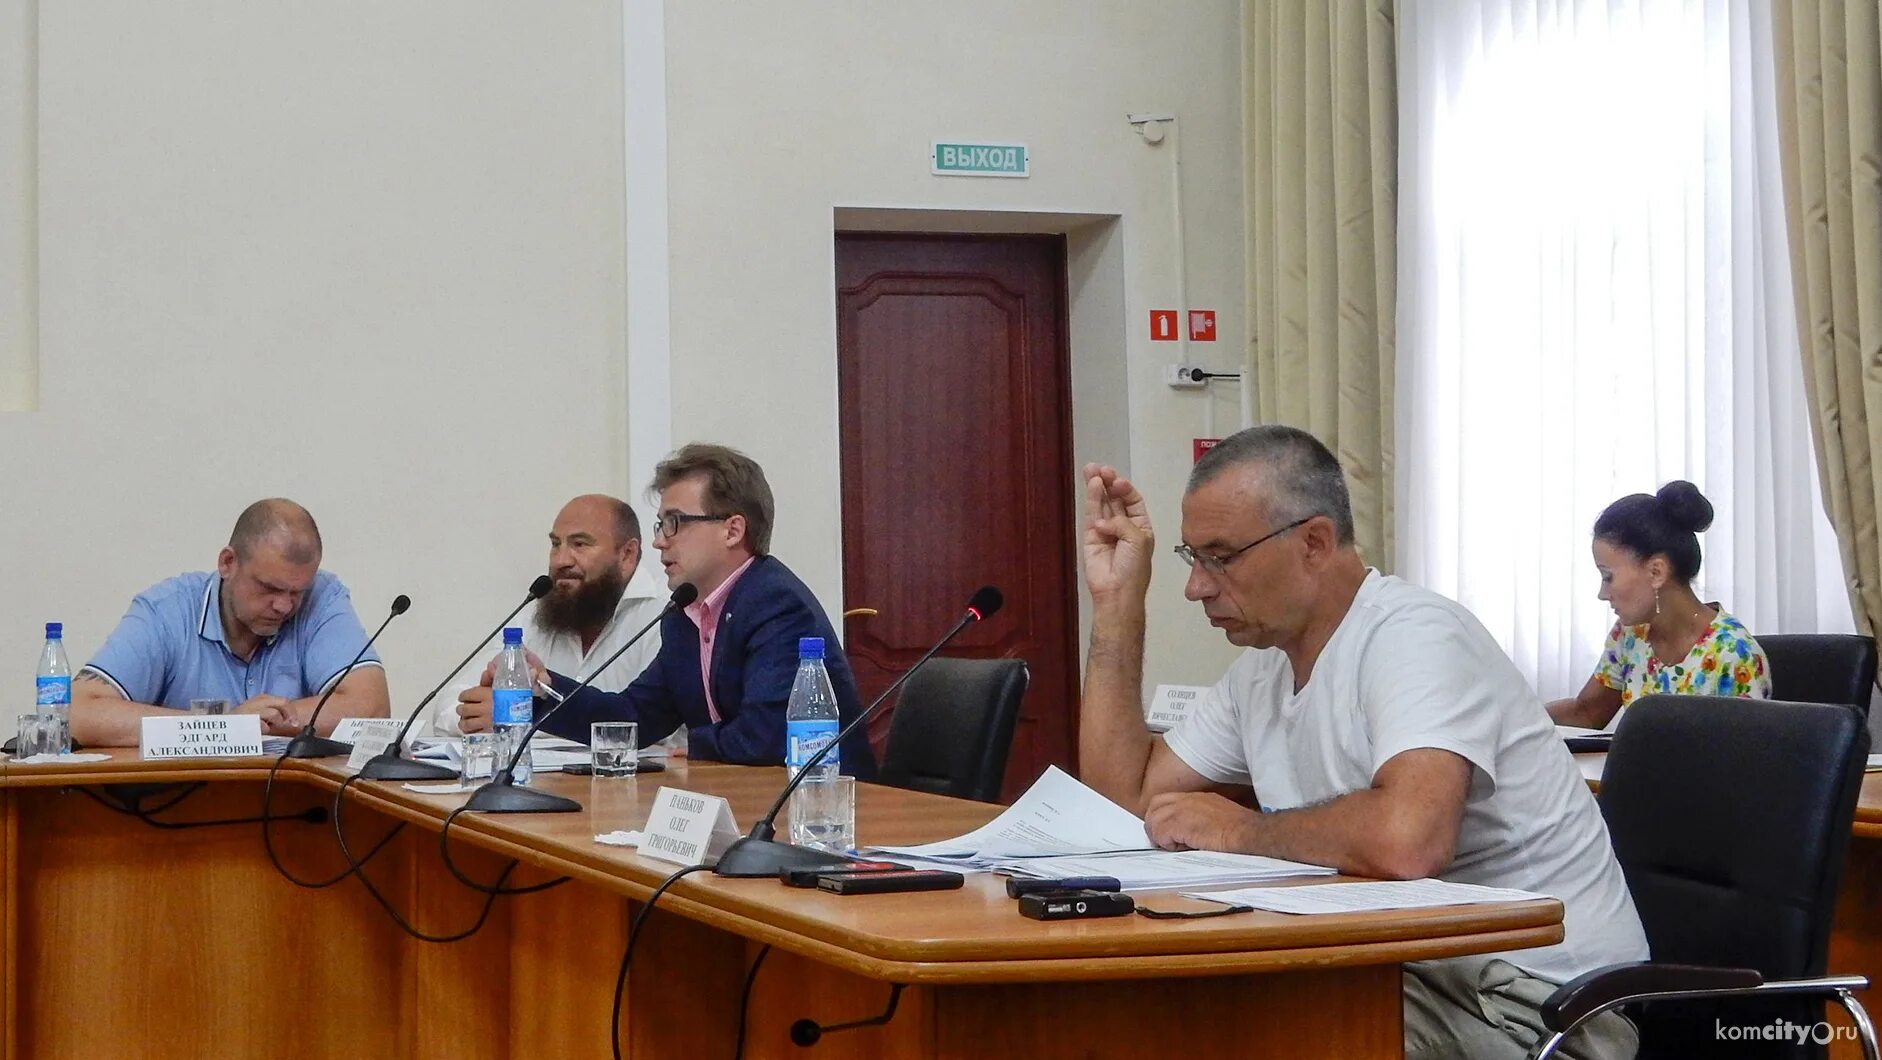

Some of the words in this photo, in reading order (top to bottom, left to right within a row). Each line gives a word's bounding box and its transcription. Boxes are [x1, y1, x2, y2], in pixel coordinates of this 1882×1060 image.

[943, 147, 1017, 170] ВЫХОД
[178, 720, 227, 731] ЗАЙЦЕВ
[179, 733, 228, 744] ЭДГАРД
[148, 745, 259, 756] АЛЕКСАНДРОВИЧ
[670, 794, 705, 814] ПАНЬКОВ
[669, 816, 690, 832] ОЛЕГ
[648, 833, 698, 858] ГРИГОРЬЕВИЧ
